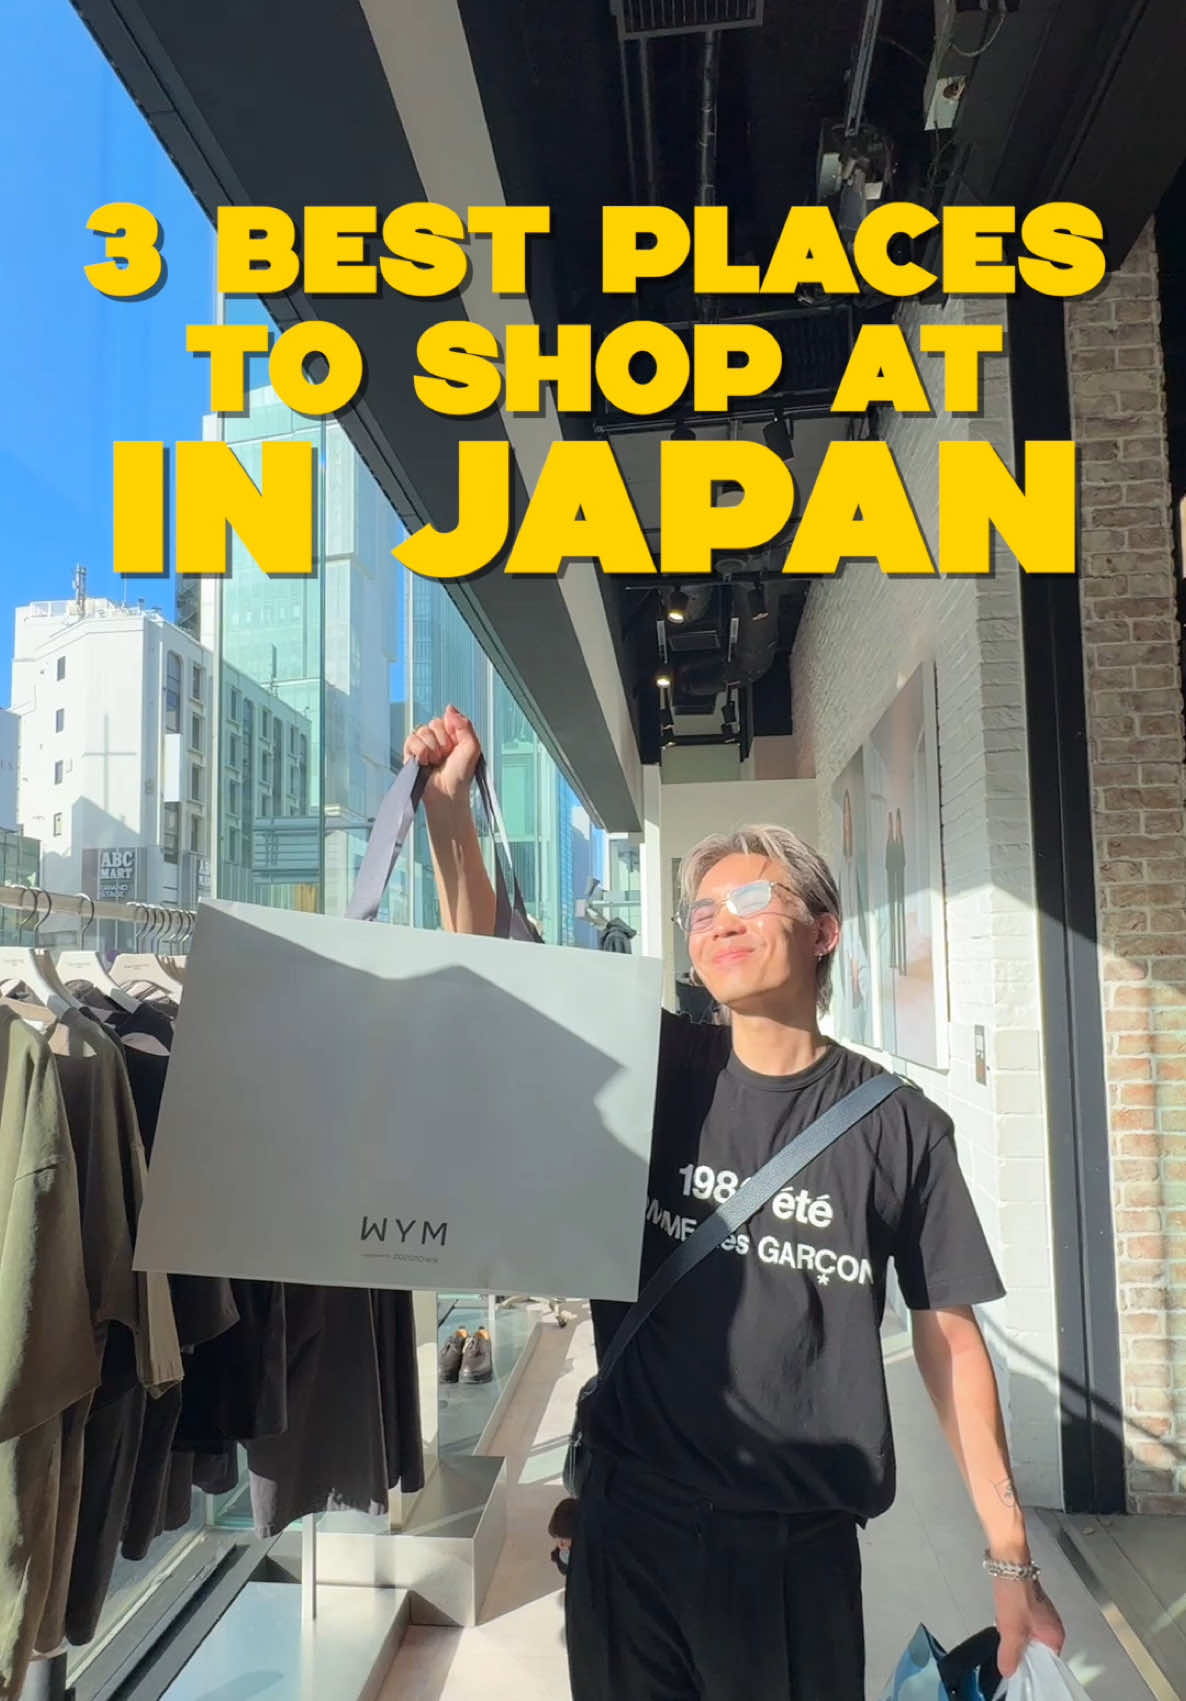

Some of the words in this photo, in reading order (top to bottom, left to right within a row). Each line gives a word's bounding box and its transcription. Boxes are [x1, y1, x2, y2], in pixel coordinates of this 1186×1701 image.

[101, 851, 133, 868] ABC
[100, 868, 132, 879] MART
[679, 1163, 752, 1204] 198
[771, 1186, 834, 1229] été
[360, 1215, 448, 1247] WYM
